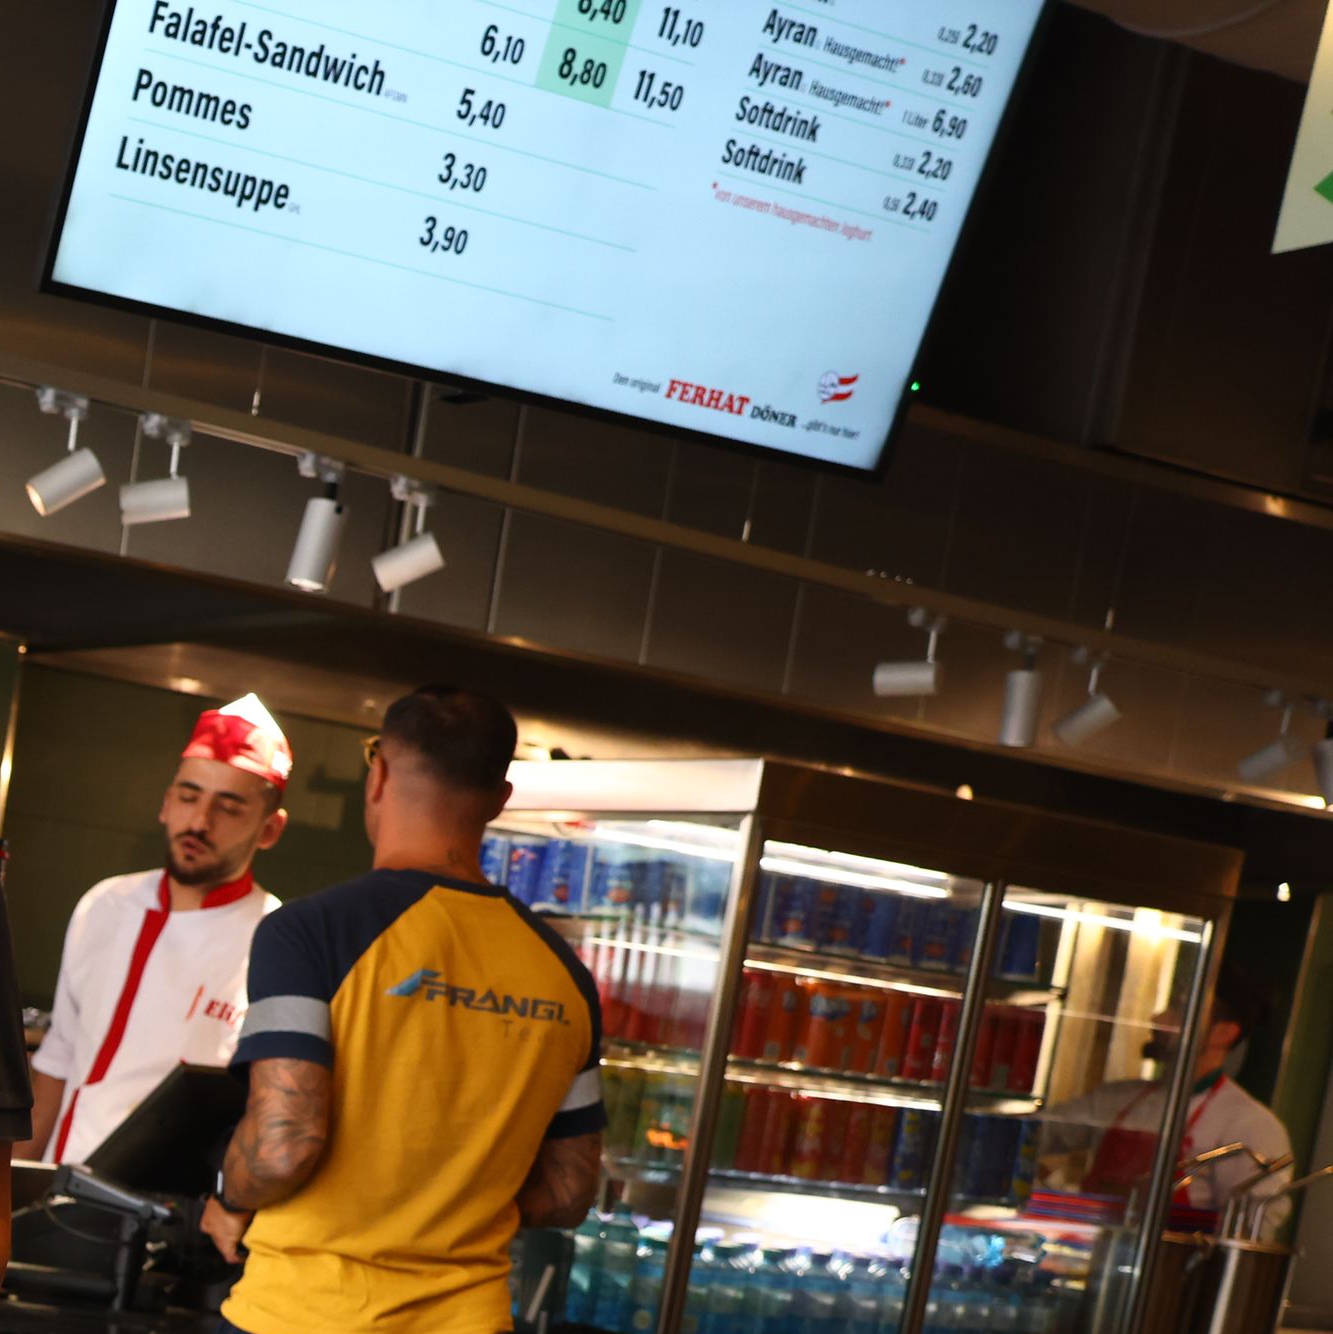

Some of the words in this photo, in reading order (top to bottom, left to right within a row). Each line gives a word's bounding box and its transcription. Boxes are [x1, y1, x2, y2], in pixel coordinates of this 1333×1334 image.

[148, 1, 386, 96] Falafel-Sandwich
[457, 88, 506, 129] 5,40
[481, 24, 525, 65] 6,10
[558, 48, 607, 89] 8,80
[634, 70, 684, 111] 11,50
[658, 7, 704, 48] 11,10
[762, 9, 817, 47] Ayran
[946, 67, 983, 98] 2,60
[961, 24, 998, 55] 2,20
[132, 69, 252, 130] Pommes
[438, 153, 487, 192] 3,30
[736, 96, 821, 142] Softdrink
[917, 151, 953, 181] 2,20
[748, 53, 803, 91] Ayran
[932, 108, 968, 139] 6,90
[116, 136, 290, 211] Linsensuppe
[419, 216, 468, 255] 3,90
[721, 139, 807, 184] Softdrink
[902, 192, 938, 221] 2,40
[665, 379, 750, 416] FERHAT
[750, 405, 797, 428] DÖNER
